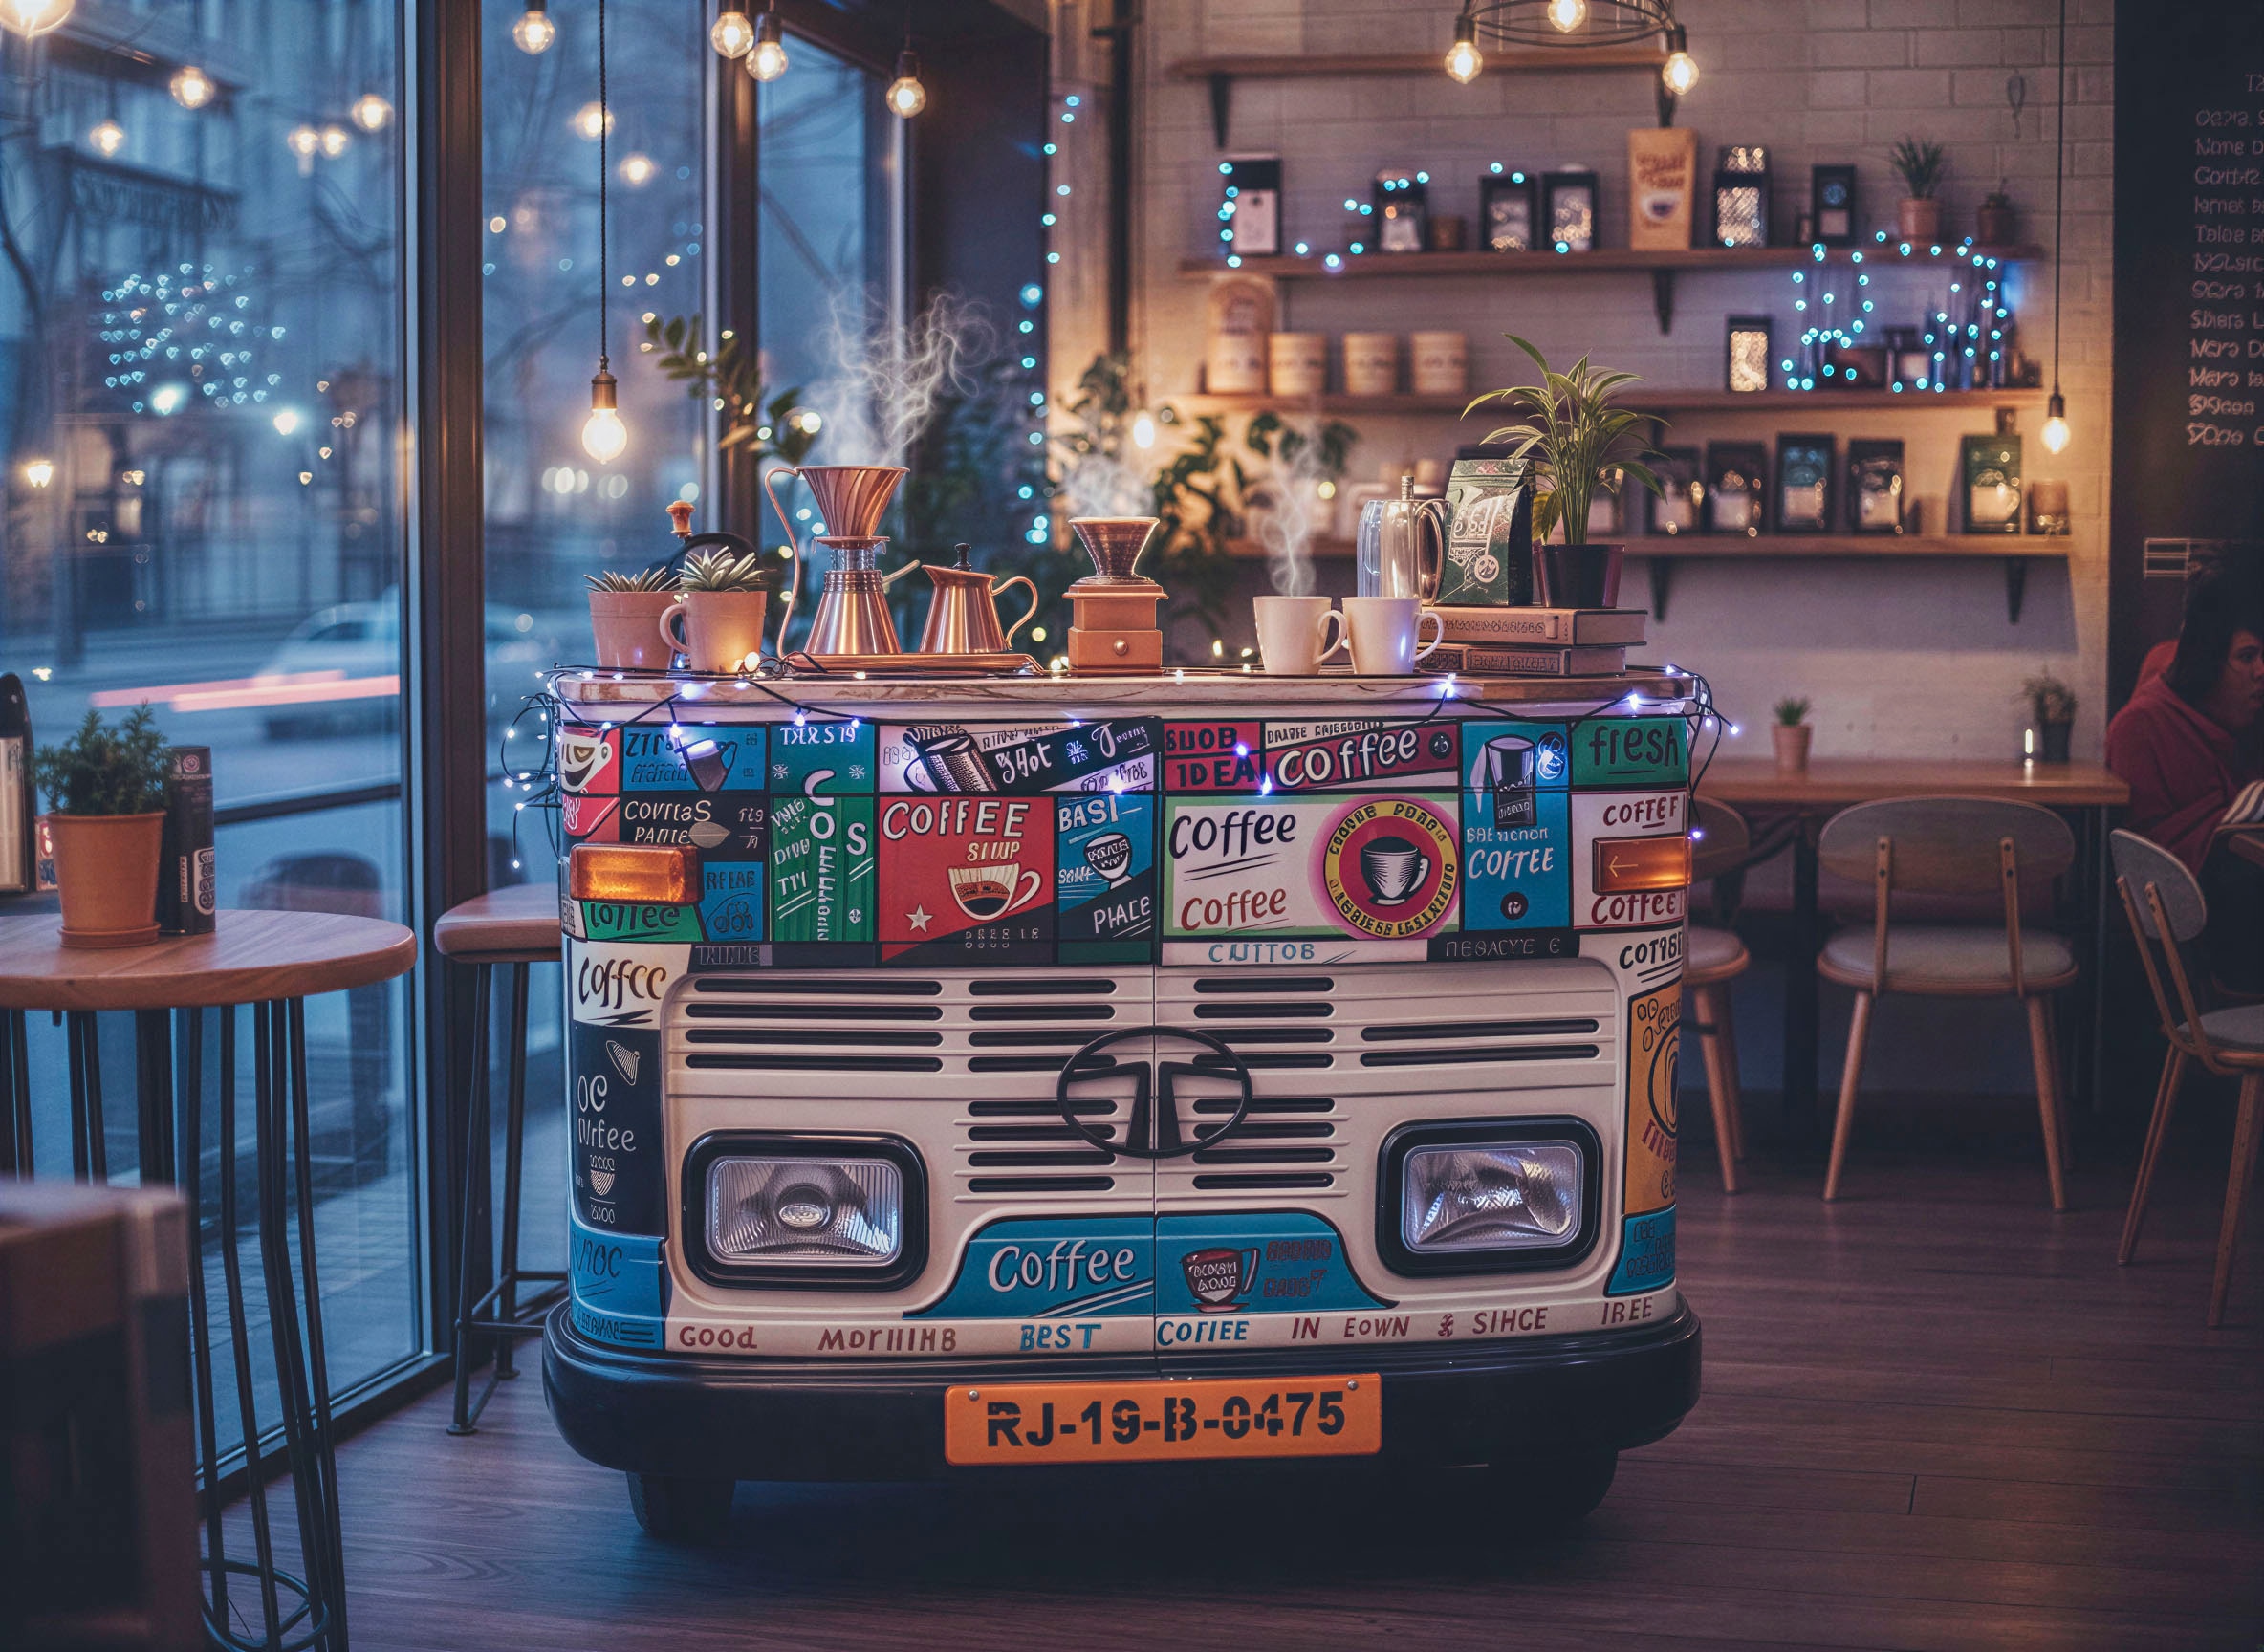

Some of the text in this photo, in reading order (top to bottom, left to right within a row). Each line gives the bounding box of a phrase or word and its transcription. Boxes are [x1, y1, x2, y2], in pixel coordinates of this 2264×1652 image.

[1168, 810, 1297, 859] Coffee
[1181, 888, 1287, 931] Coffee
[988, 1239, 1136, 1293] Coffee
[679, 1325, 757, 1351] Good
[1292, 1316, 1320, 1339] IN
[987, 1390, 1345, 1447] RJ-19-B-0475
